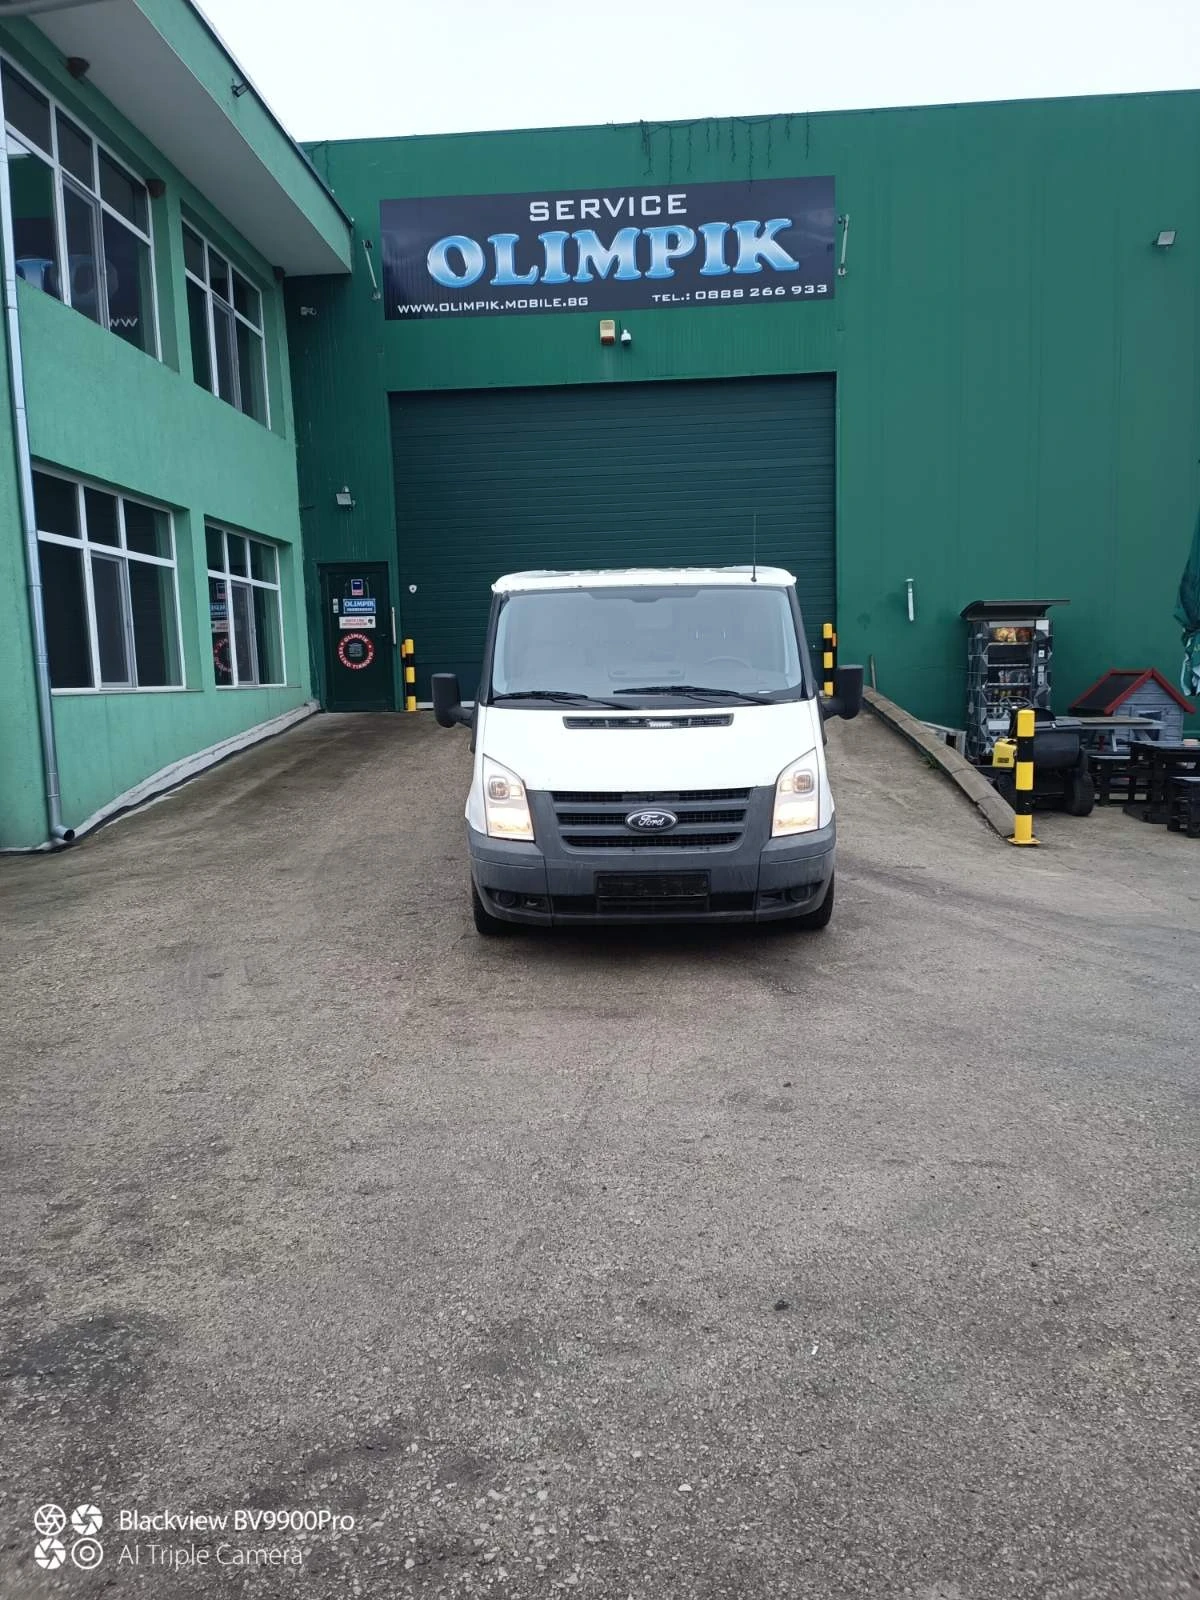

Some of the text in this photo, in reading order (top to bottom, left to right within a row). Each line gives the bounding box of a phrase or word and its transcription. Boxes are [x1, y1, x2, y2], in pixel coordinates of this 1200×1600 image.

[529, 193, 688, 222] SERVICE
[426, 218, 800, 289] OLIMPIK
[652, 284, 828, 302] TEL.: 0888 266 933
[397, 297, 589, 313] WWW.OLIMPIK.MOBILE.BG
[638, 814, 664, 827] Ford
